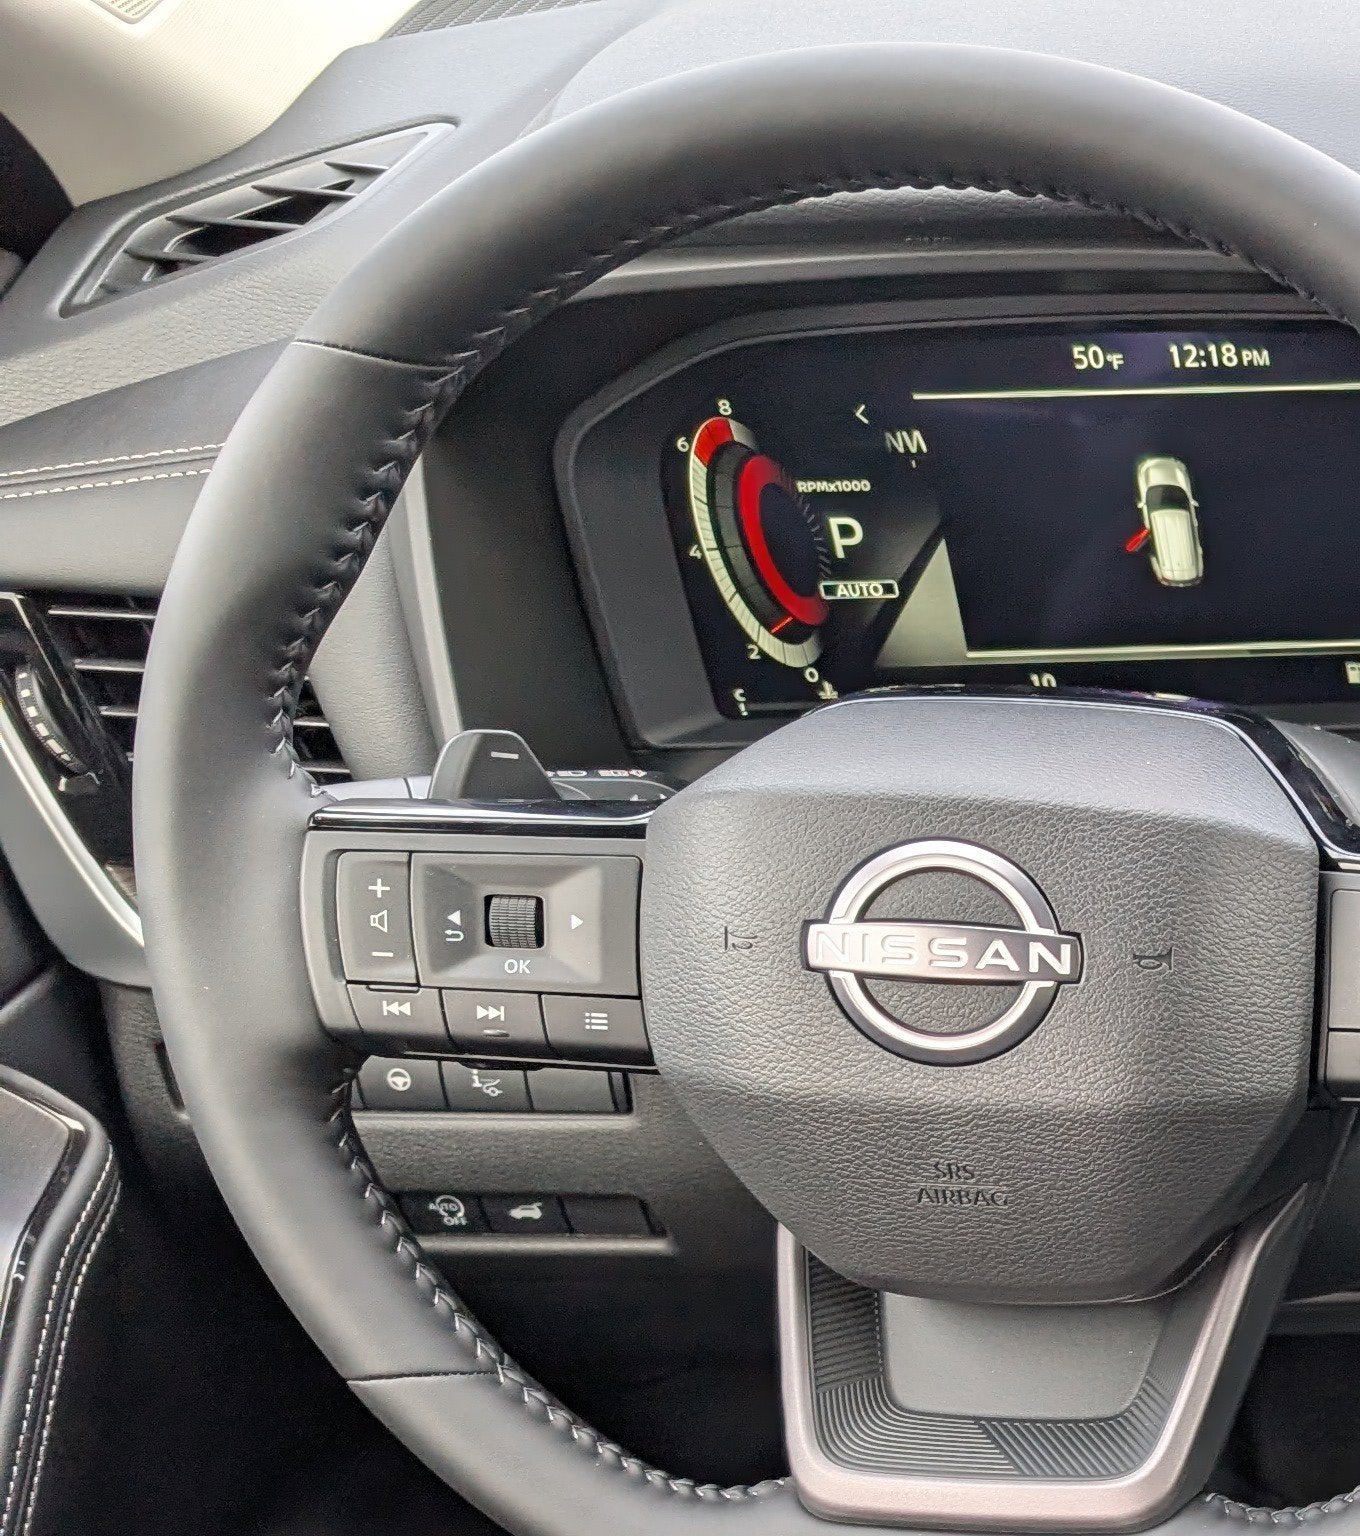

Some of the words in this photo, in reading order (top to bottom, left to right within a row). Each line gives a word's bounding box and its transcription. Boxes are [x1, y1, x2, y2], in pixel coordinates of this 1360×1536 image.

[1072, 345, 1105, 371] 50
[1169, 343, 1238, 369] 12:18
[1242, 350, 1271, 367] PM
[717, 399, 732, 416] 8
[676, 437, 690, 452] 6
[796, 479, 871, 494] RPMx1000
[828, 516, 864, 559] P
[688, 545, 702, 560] 4
[836, 583, 883, 598] AUTO
[747, 644, 762, 660] 2
[804, 667, 819, 683] 0
[815, 926, 1072, 976] NISSAN
[504, 959, 531, 974] OK
[933, 1161, 975, 1181] SRS
[917, 1187, 1009, 1207] AIRBAG
